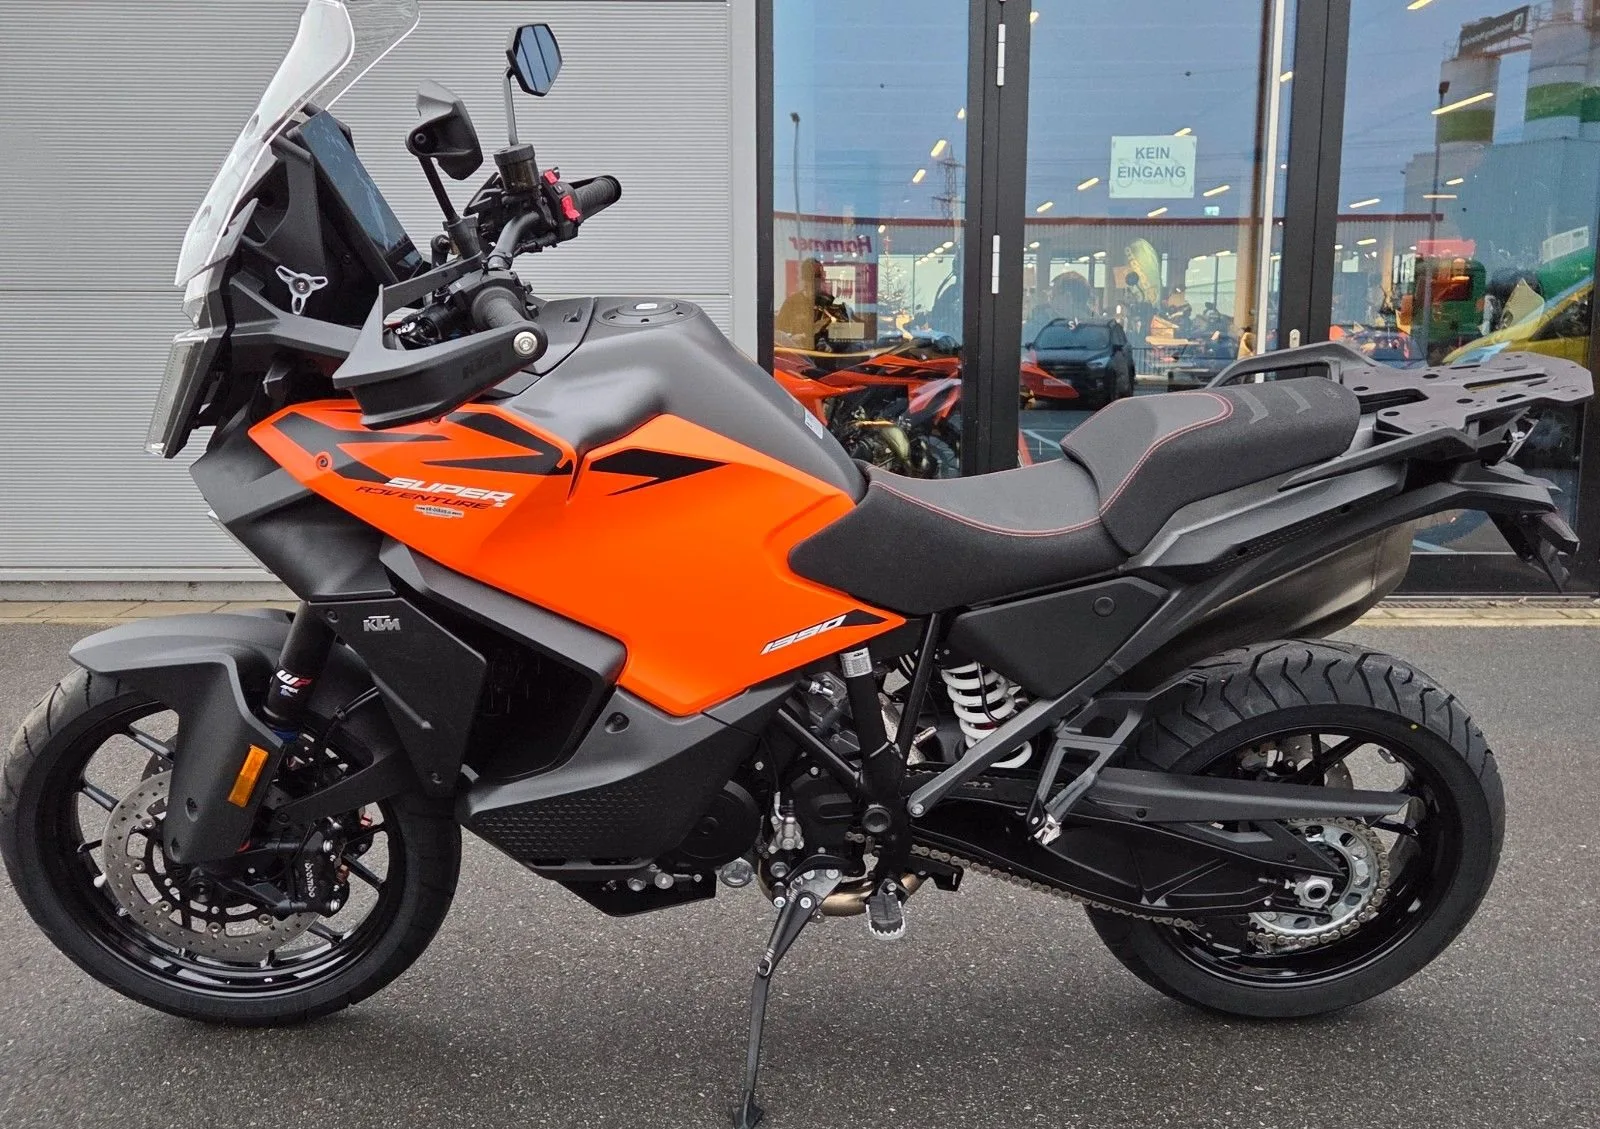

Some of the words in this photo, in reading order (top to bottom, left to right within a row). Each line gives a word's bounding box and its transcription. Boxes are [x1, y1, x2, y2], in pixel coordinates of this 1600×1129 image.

[1135, 146, 1170, 160] KEIN
[1117, 165, 1186, 179] EINGANG
[355, 486, 489, 510] ADVENTURE
[383, 476, 515, 502] SUPER
[363, 615, 401, 632] KTM
[304, 862, 317, 898] brembo
